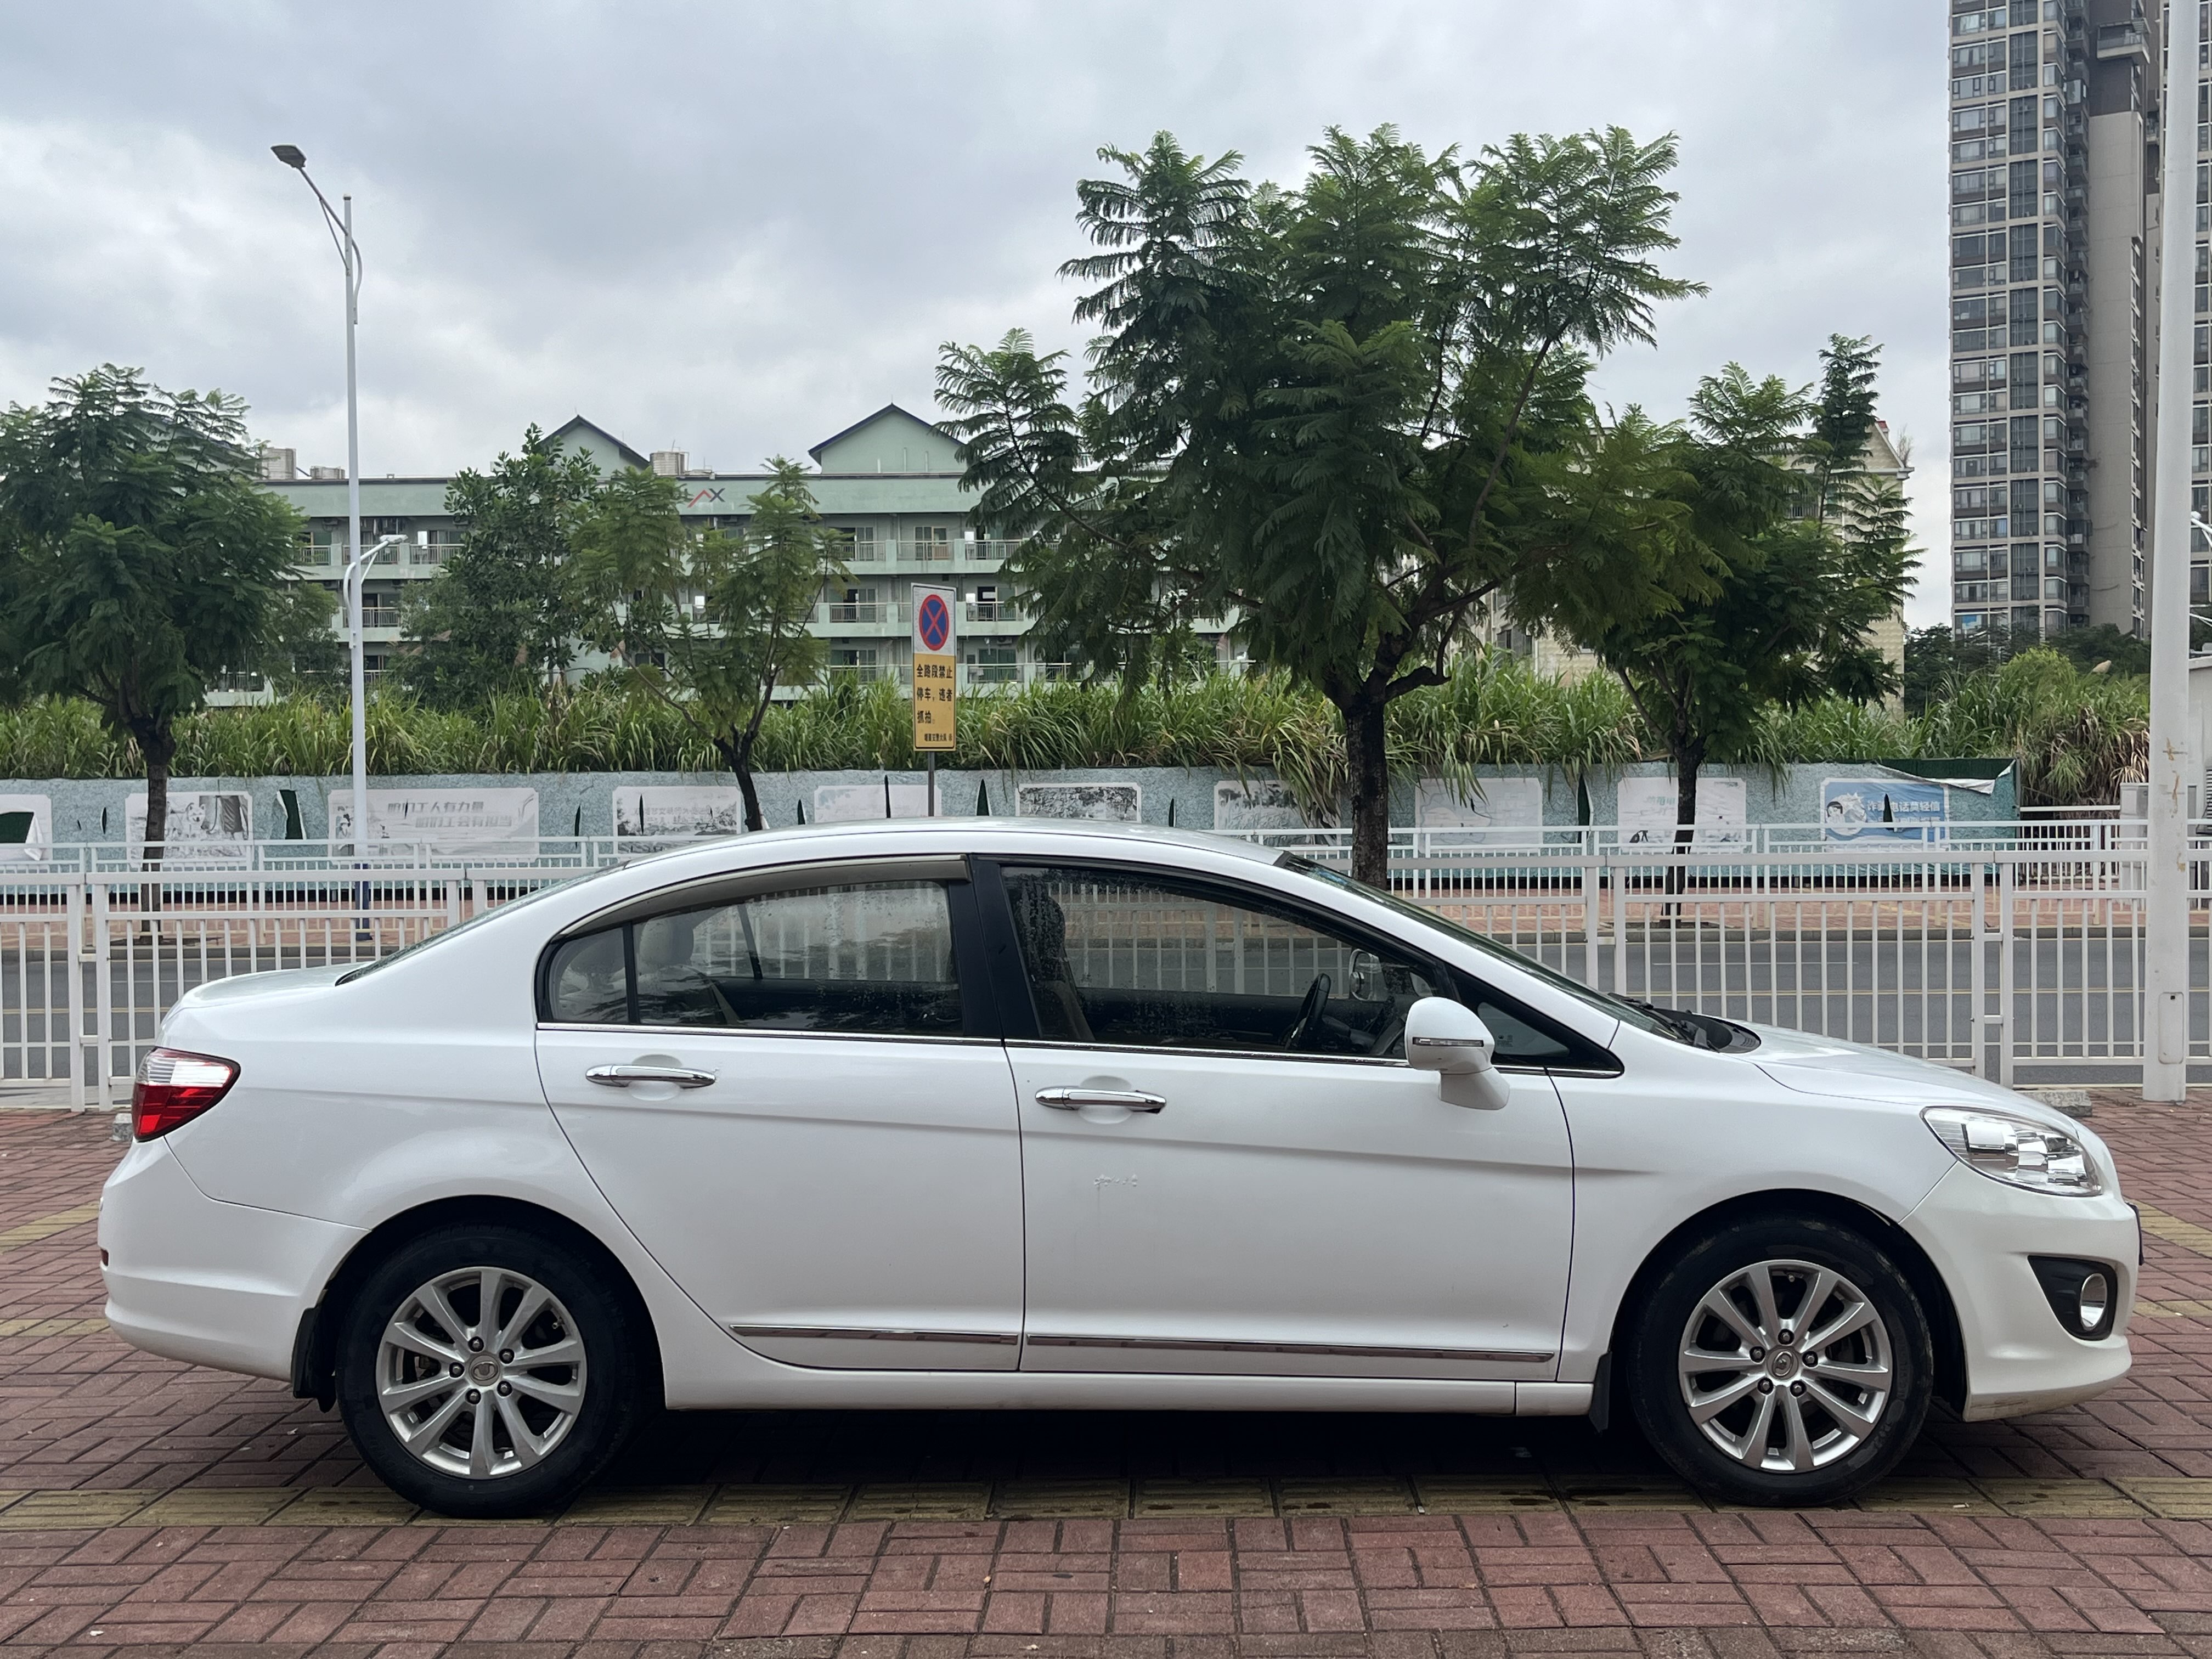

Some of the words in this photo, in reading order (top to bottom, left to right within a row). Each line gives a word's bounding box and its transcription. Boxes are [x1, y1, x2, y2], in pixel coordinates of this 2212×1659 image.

[917, 664, 952, 679] 全路段禁止
[917, 687, 952, 701] 停车，违者
[387, 801, 484, 813] 咱们工人有力量
[415, 815, 513, 828] 咱们工会有担当
